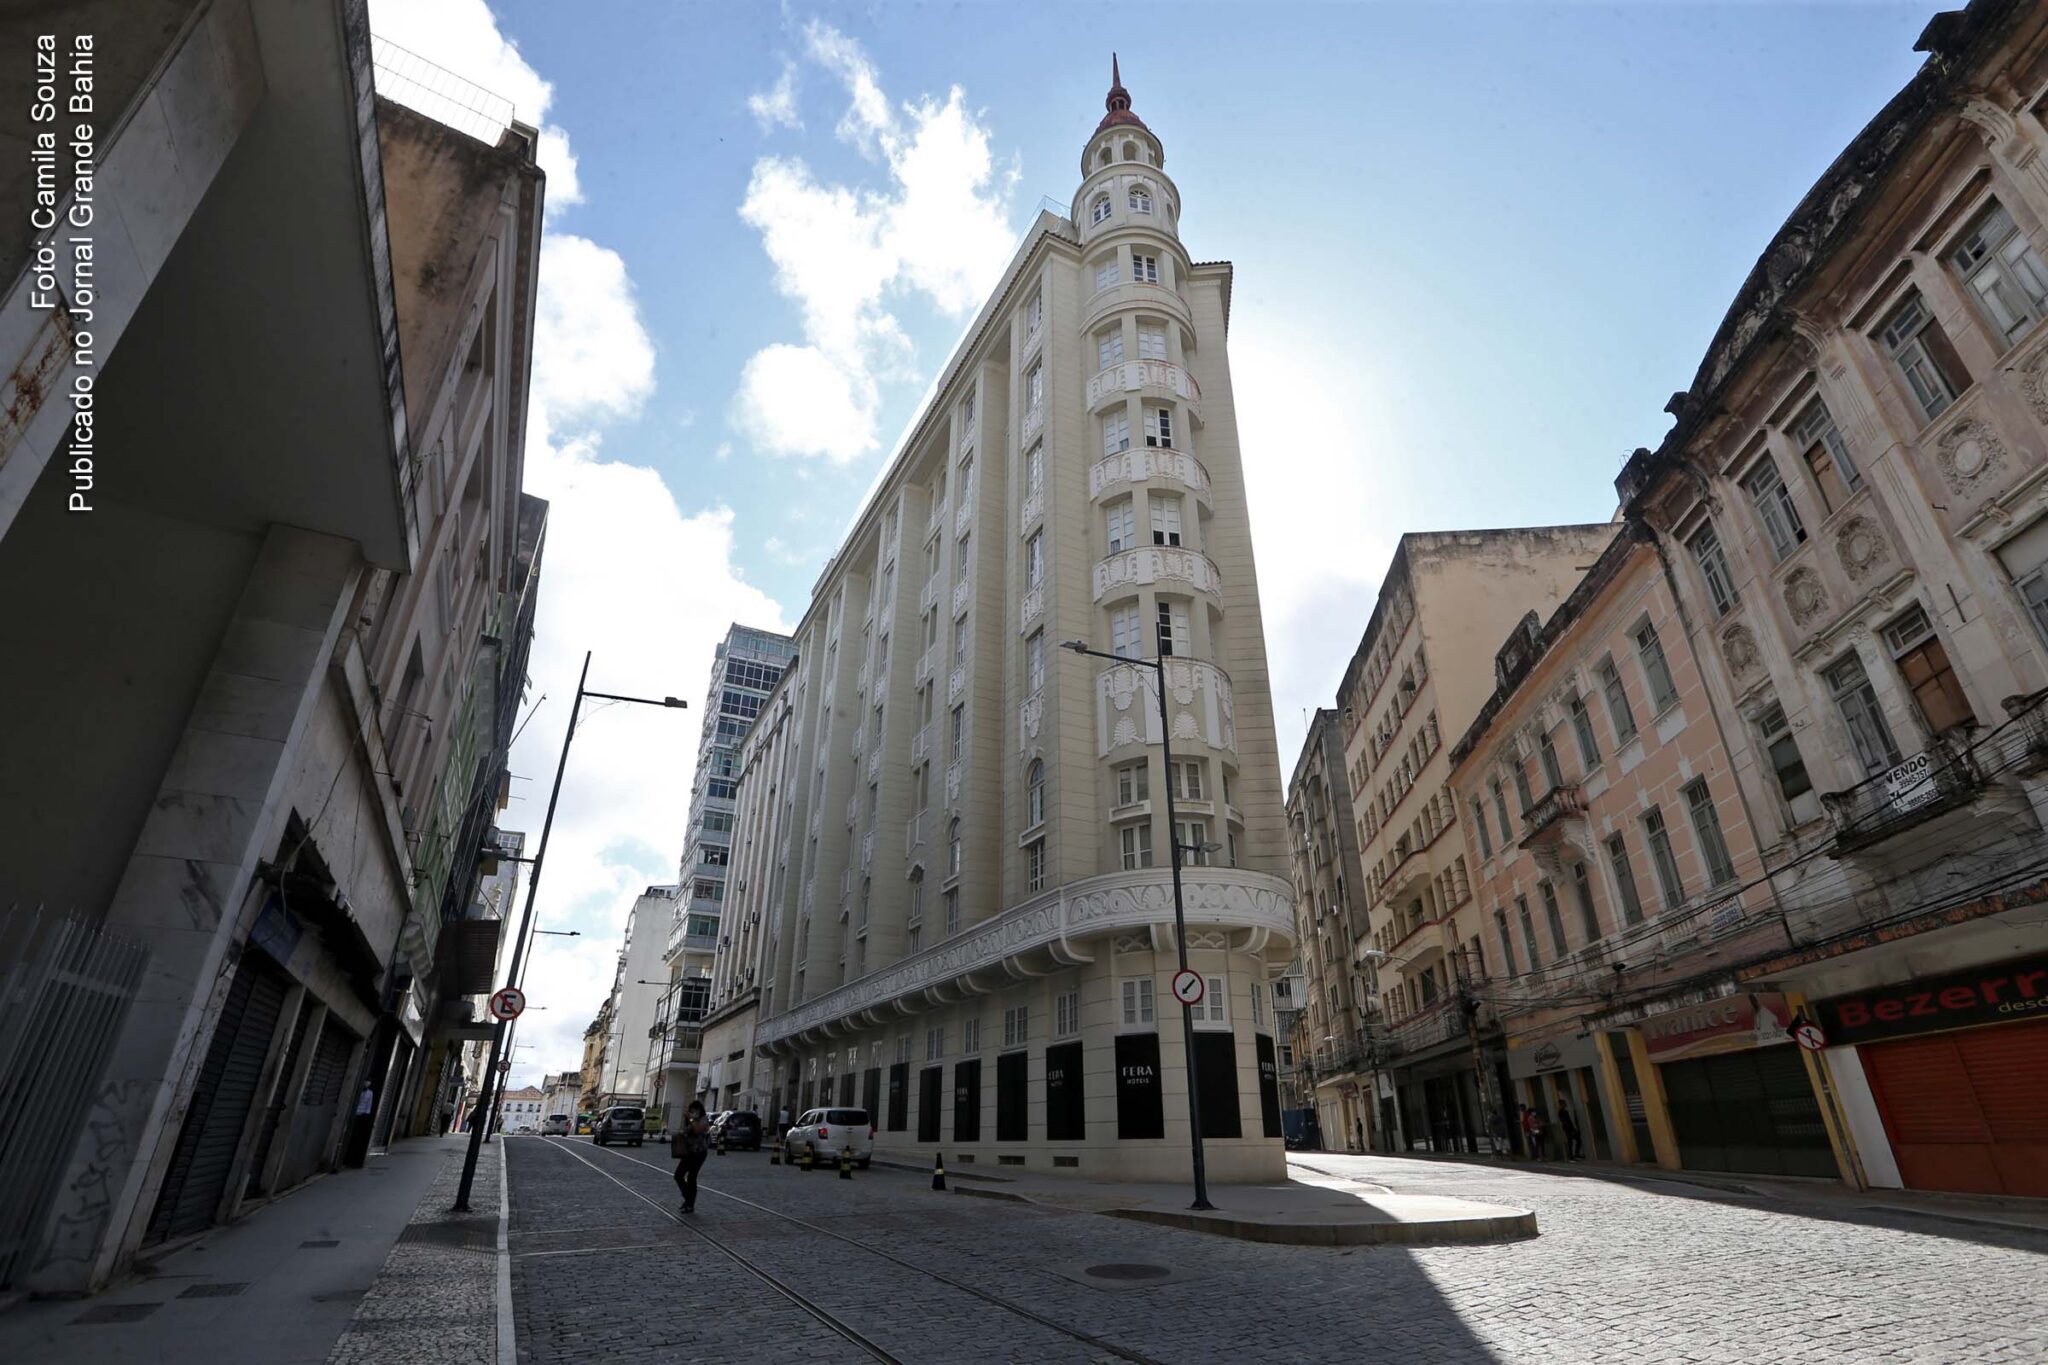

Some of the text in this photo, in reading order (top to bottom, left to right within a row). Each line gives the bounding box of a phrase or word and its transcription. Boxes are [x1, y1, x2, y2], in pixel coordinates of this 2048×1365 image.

[1886, 756, 1927, 784] VENDO
[500, 994, 516, 1013] E
[1837, 970, 2047, 1028] Bezerr
[1649, 1005, 1738, 1040] Ivanice
[1122, 1065, 1153, 1077] FERA
